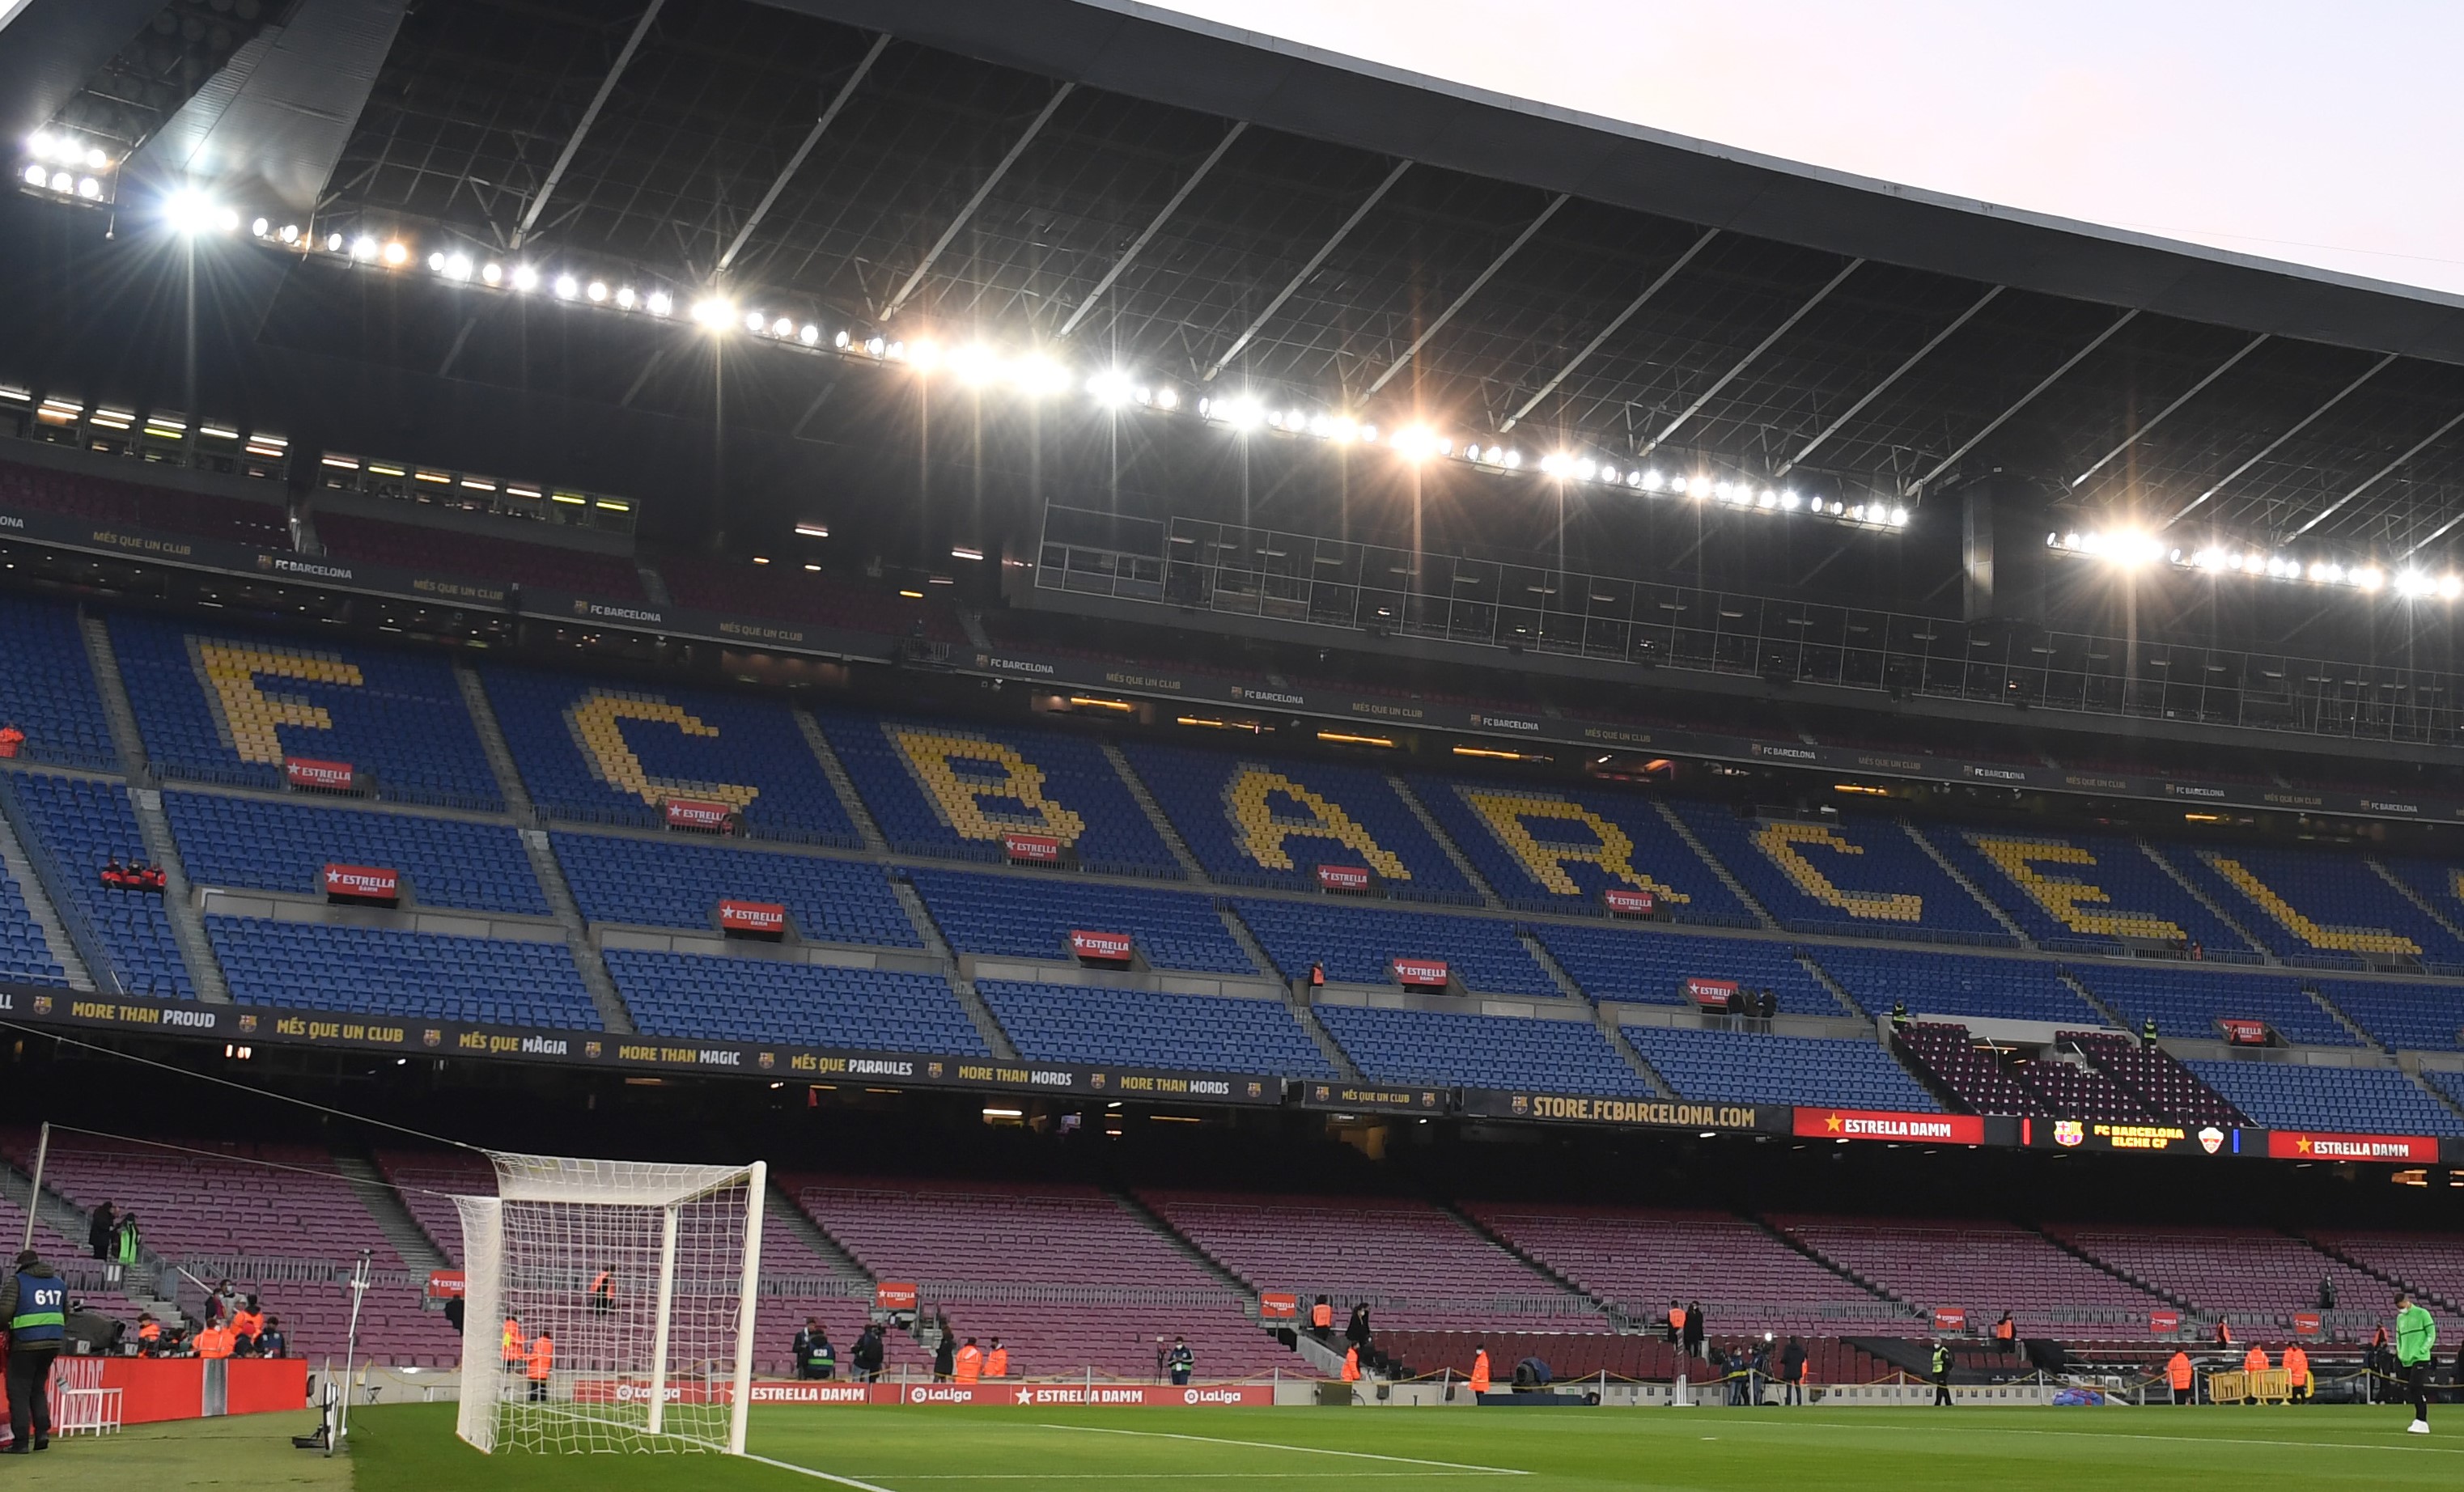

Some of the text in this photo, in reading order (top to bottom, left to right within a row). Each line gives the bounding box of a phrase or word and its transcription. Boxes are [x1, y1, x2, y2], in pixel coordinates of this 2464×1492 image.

[93, 531, 192, 556] MÉS QUE UN CLUB
[275, 559, 353, 579] FC BARCELONA
[438, 583, 459, 596] QUE
[461, 587, 476, 596] UN
[478, 589, 503, 601] CLUB
[591, 604, 662, 623] FC BARCELONA
[742, 625, 761, 637] QUE
[763, 629, 778, 638] UN
[778, 631, 804, 642] CLUB
[990, 658, 1054, 674] FC BARCELONA
[1245, 689, 1304, 705] FC BARCELONA
[1483, 717, 1540, 731] FC BARCELONA
[1763, 746, 1817, 760] FC BARCELONA
[302, 767, 351, 781] ESTRELLA
[1974, 768, 2025, 780] FC BARCELONA
[2177, 786, 2225, 797] FC BARCELONA
[2371, 802, 2379, 810] FC
[1017, 843, 1057, 854] ESTRELLA
[342, 874, 395, 888] ESTRELLA
[1330, 872, 1368, 884] ESTRELLA
[1618, 897, 1652, 908] ESTRELLA
[736, 909, 782, 923] ESTRELLA
[1086, 939, 1130, 952] ESTRELLA
[1407, 967, 1447, 978] ESTRELLA
[72, 1001, 216, 1028] MORE THAN PROUD
[277, 1016, 405, 1043] MÉS QUE UN CLUB
[2230, 1026, 2263, 1036] TRELLA
[459, 1031, 568, 1055] MÉS QUE MÀGIA
[618, 1045, 741, 1066] MORE THAN MAGIC
[791, 1053, 914, 1077] MÉS QUE PARAULES
[958, 1065, 1073, 1086] MORE THAN WORDS
[1120, 1076, 1230, 1095] MORE THAN WORDS
[1342, 1088, 1410, 1104] MÉS QUE UN CLUB
[1533, 1096, 1756, 1128] STORE.FCBARCELONA.COM
[1844, 1119, 1951, 1138] ESTRELLA DAMM
[2093, 1125, 2185, 1139] FC BARCELONA
[2111, 1137, 2168, 1149] ELCHE CF
[2313, 1142, 2409, 1157] ESTRELLA DAMM
[440, 1280, 465, 1288] ESTREL
[35, 1289, 62, 1306] 617
[634, 1387, 681, 1401] Laga
[751, 1388, 865, 1401] ESTRELLA DAMM
[928, 1387, 972, 1403] LaLiga
[1101, 1390, 1143, 1403] DAMM
[1200, 1388, 1241, 1404] LaLiga
